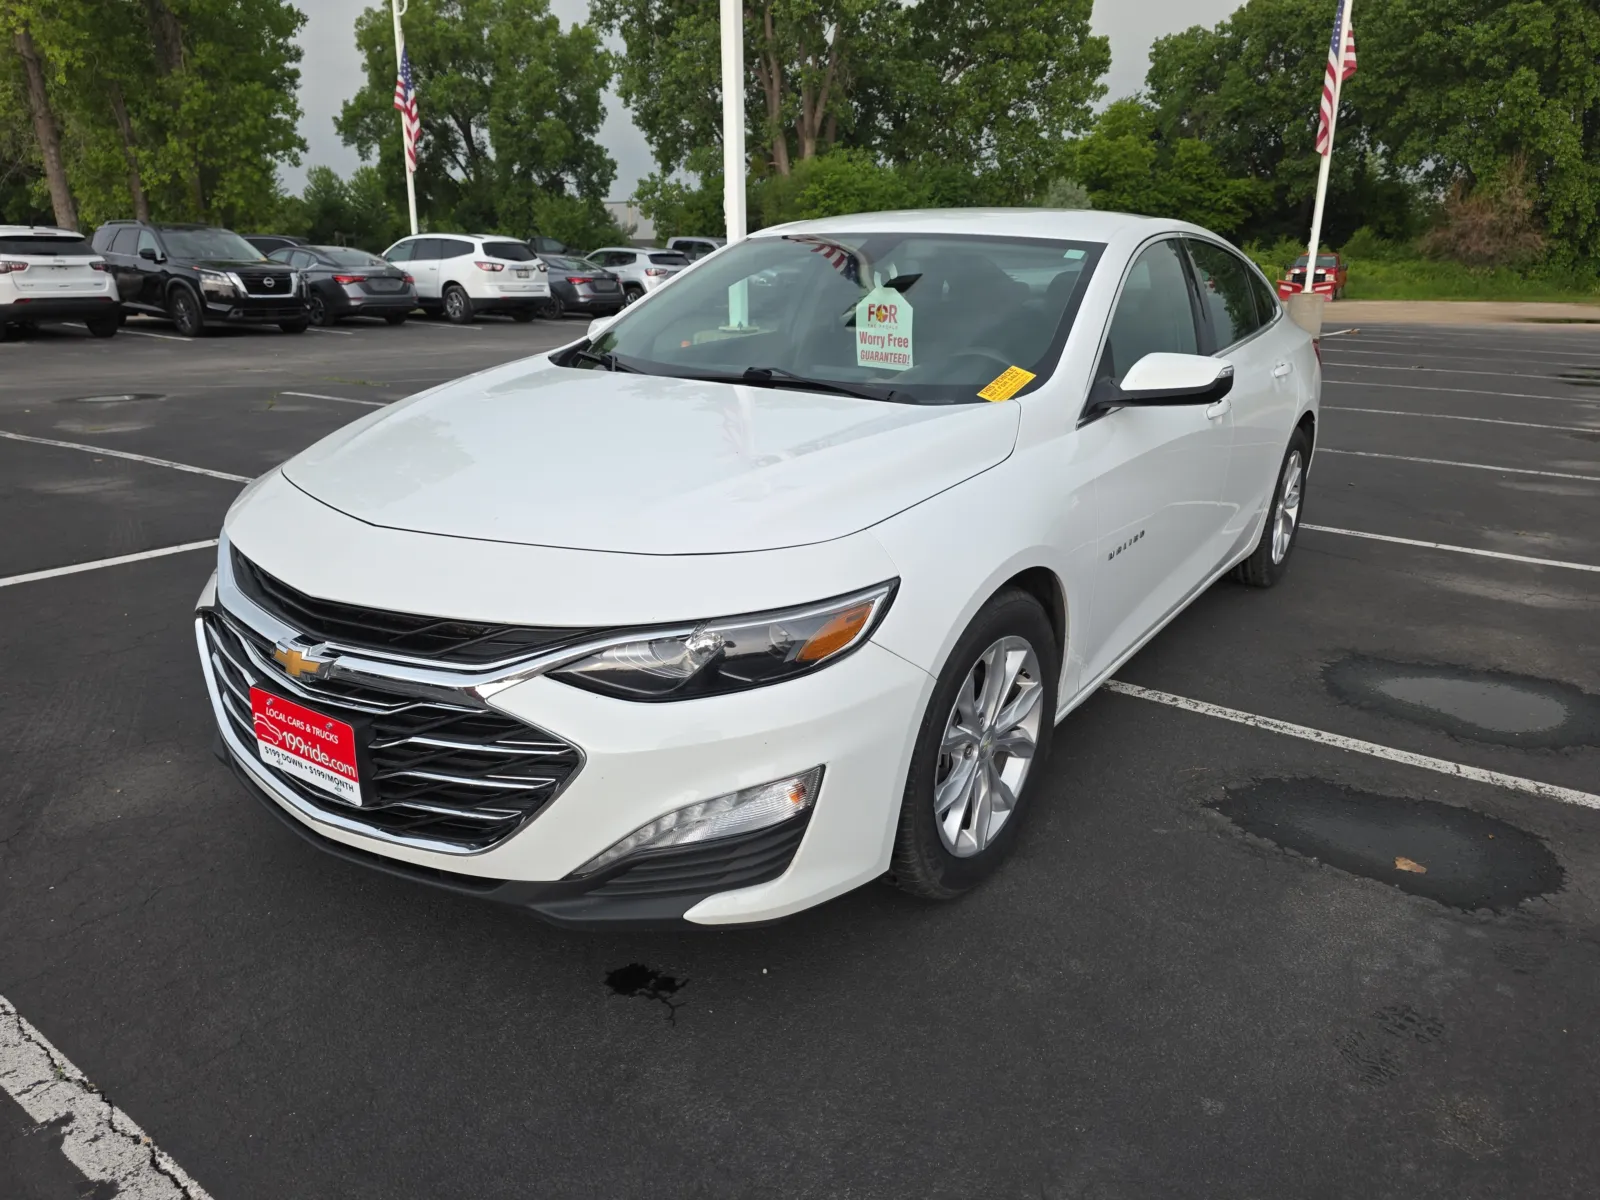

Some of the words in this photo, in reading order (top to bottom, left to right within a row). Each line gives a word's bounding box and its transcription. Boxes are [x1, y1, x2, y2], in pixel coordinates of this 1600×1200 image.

[868, 304, 898, 323] FOR
[859, 331, 886, 348] Worry
[888, 334, 909, 348] Free
[860, 350, 910, 364] GUARANTEED!
[266, 707, 287, 722] LOCAL
[287, 717, 304, 730] CARS
[306, 724, 311, 733] &
[312, 726, 338, 744] TRUCKS
[265, 746, 280, 758] $199
[282, 753, 303, 769] DOWN
[282, 731, 356, 778] 199ride.com
